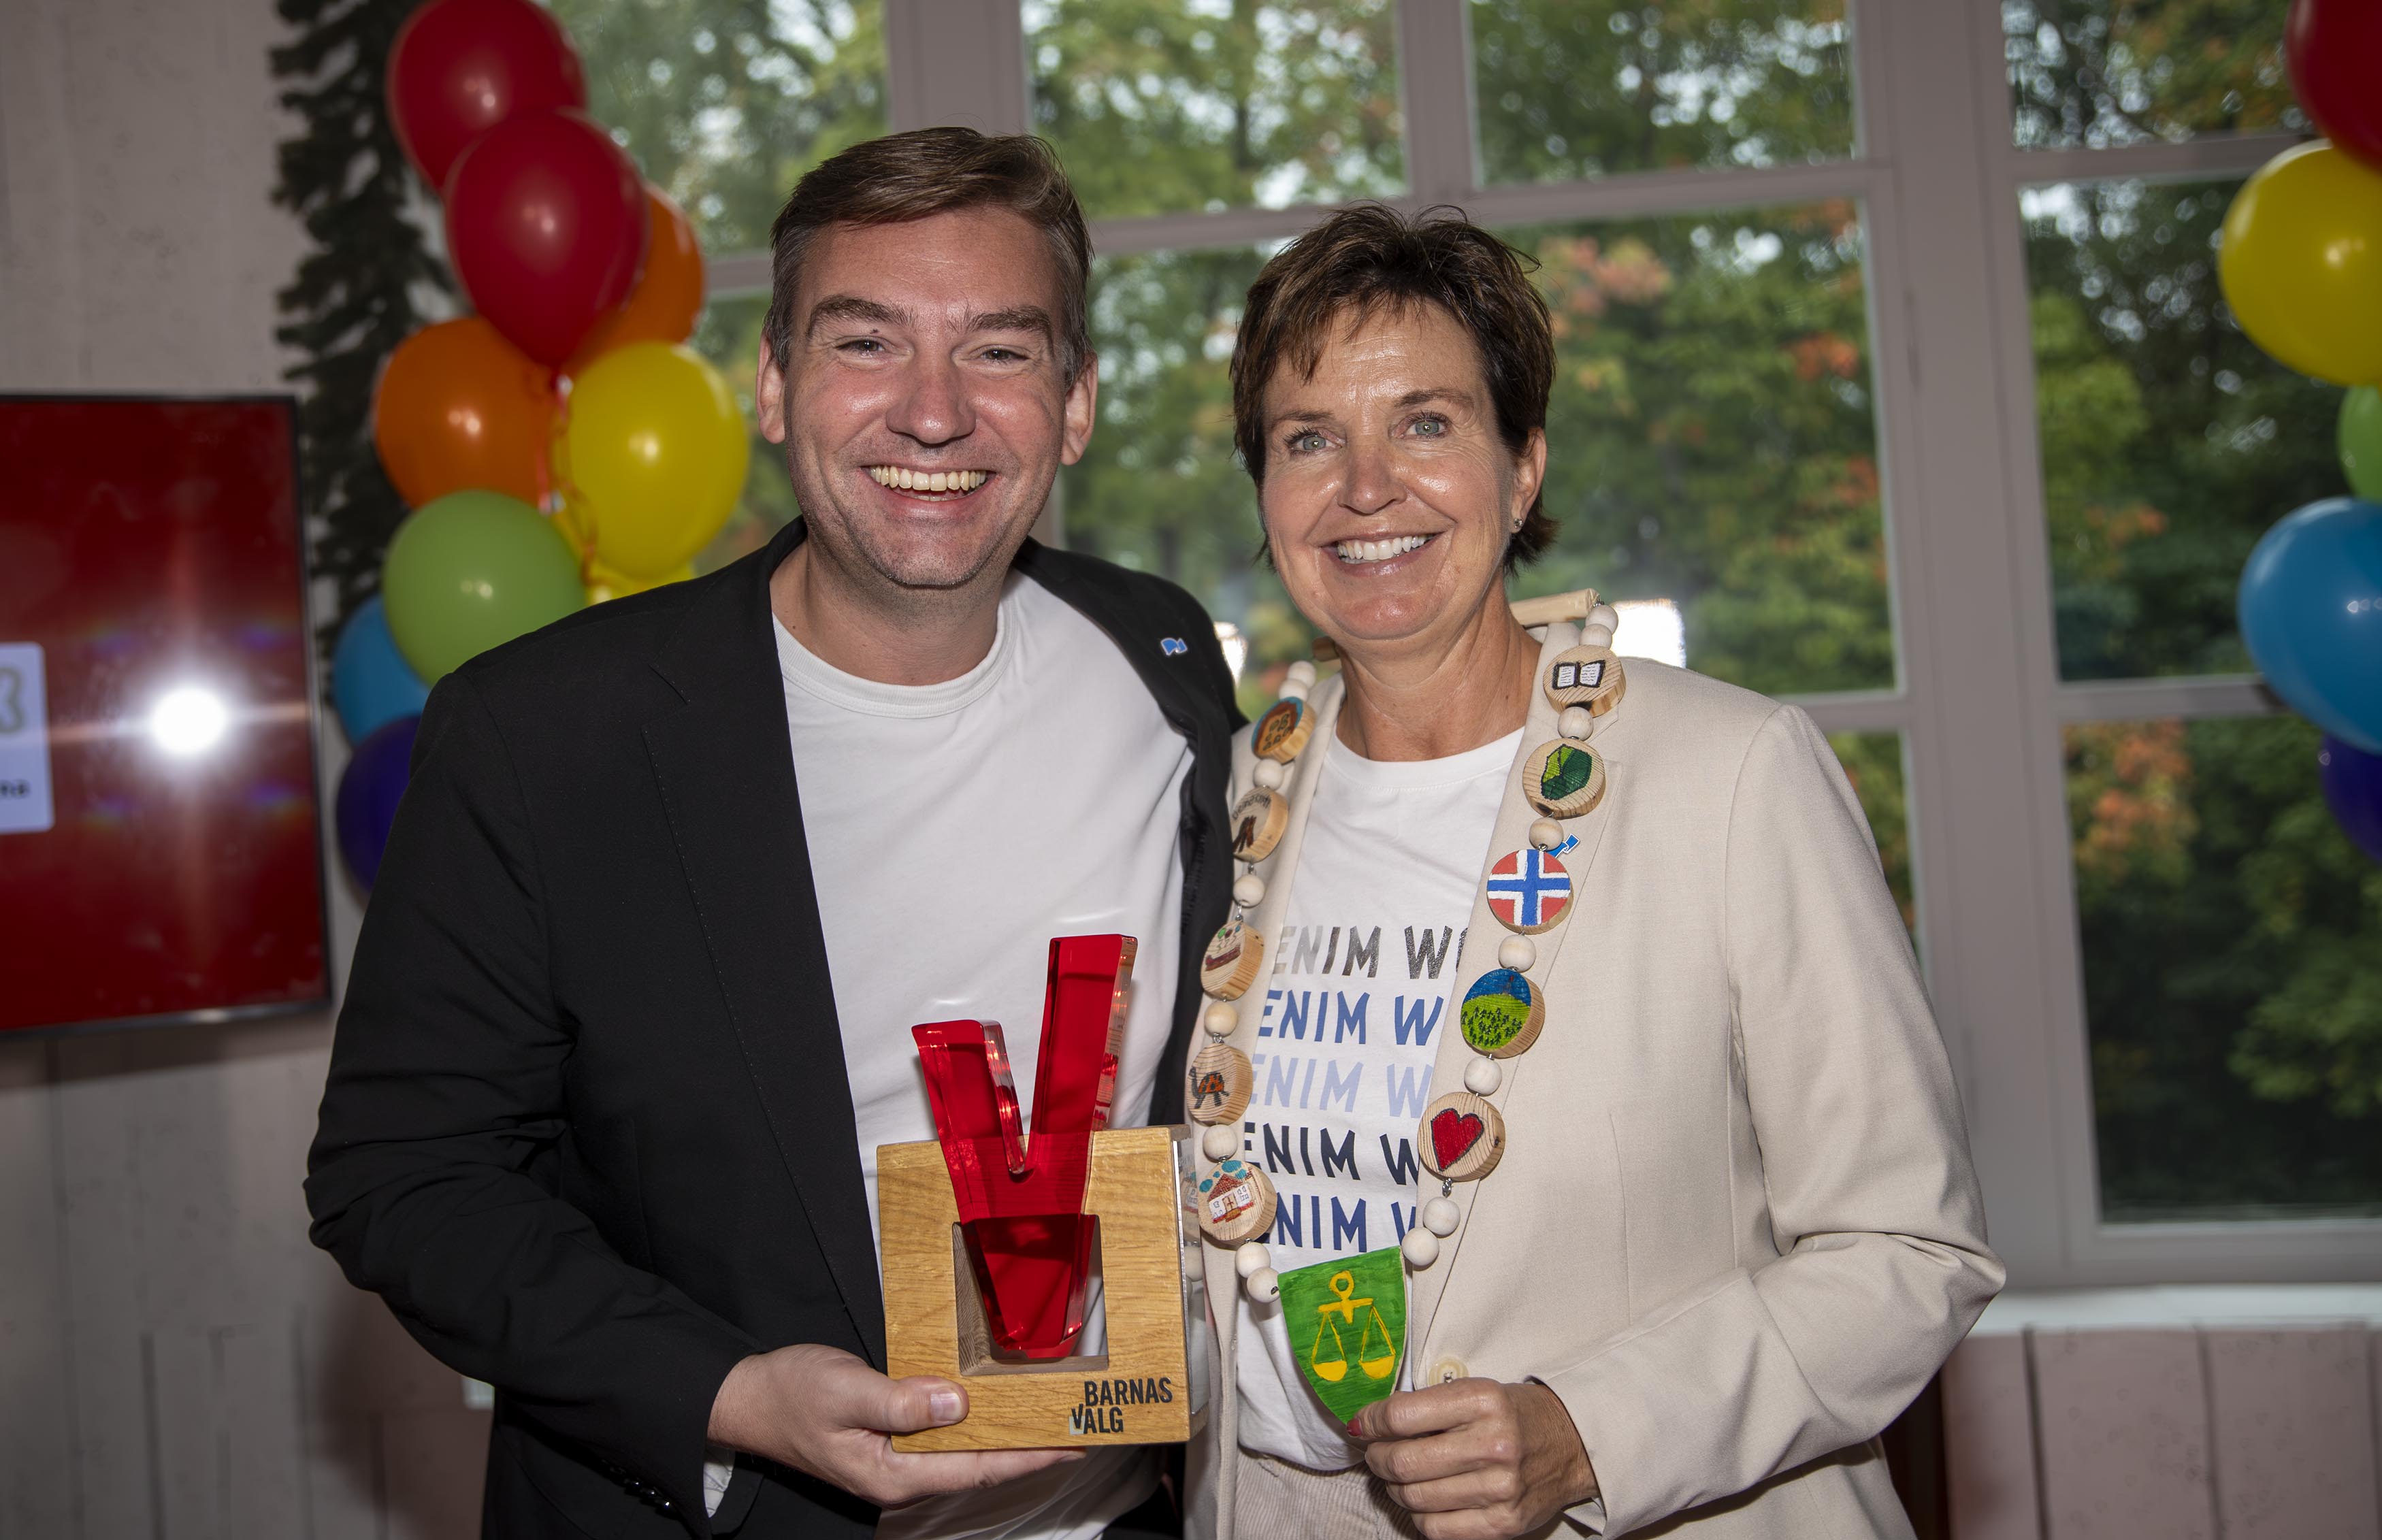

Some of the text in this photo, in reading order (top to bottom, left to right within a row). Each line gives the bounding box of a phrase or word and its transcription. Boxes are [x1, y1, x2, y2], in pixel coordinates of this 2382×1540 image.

[1259, 989, 1370, 1045] ENIM
[1255, 1192, 1367, 1253] NIM
[1084, 1377, 1173, 1407] BARNAS
[1071, 1403, 1124, 1434] VALG
